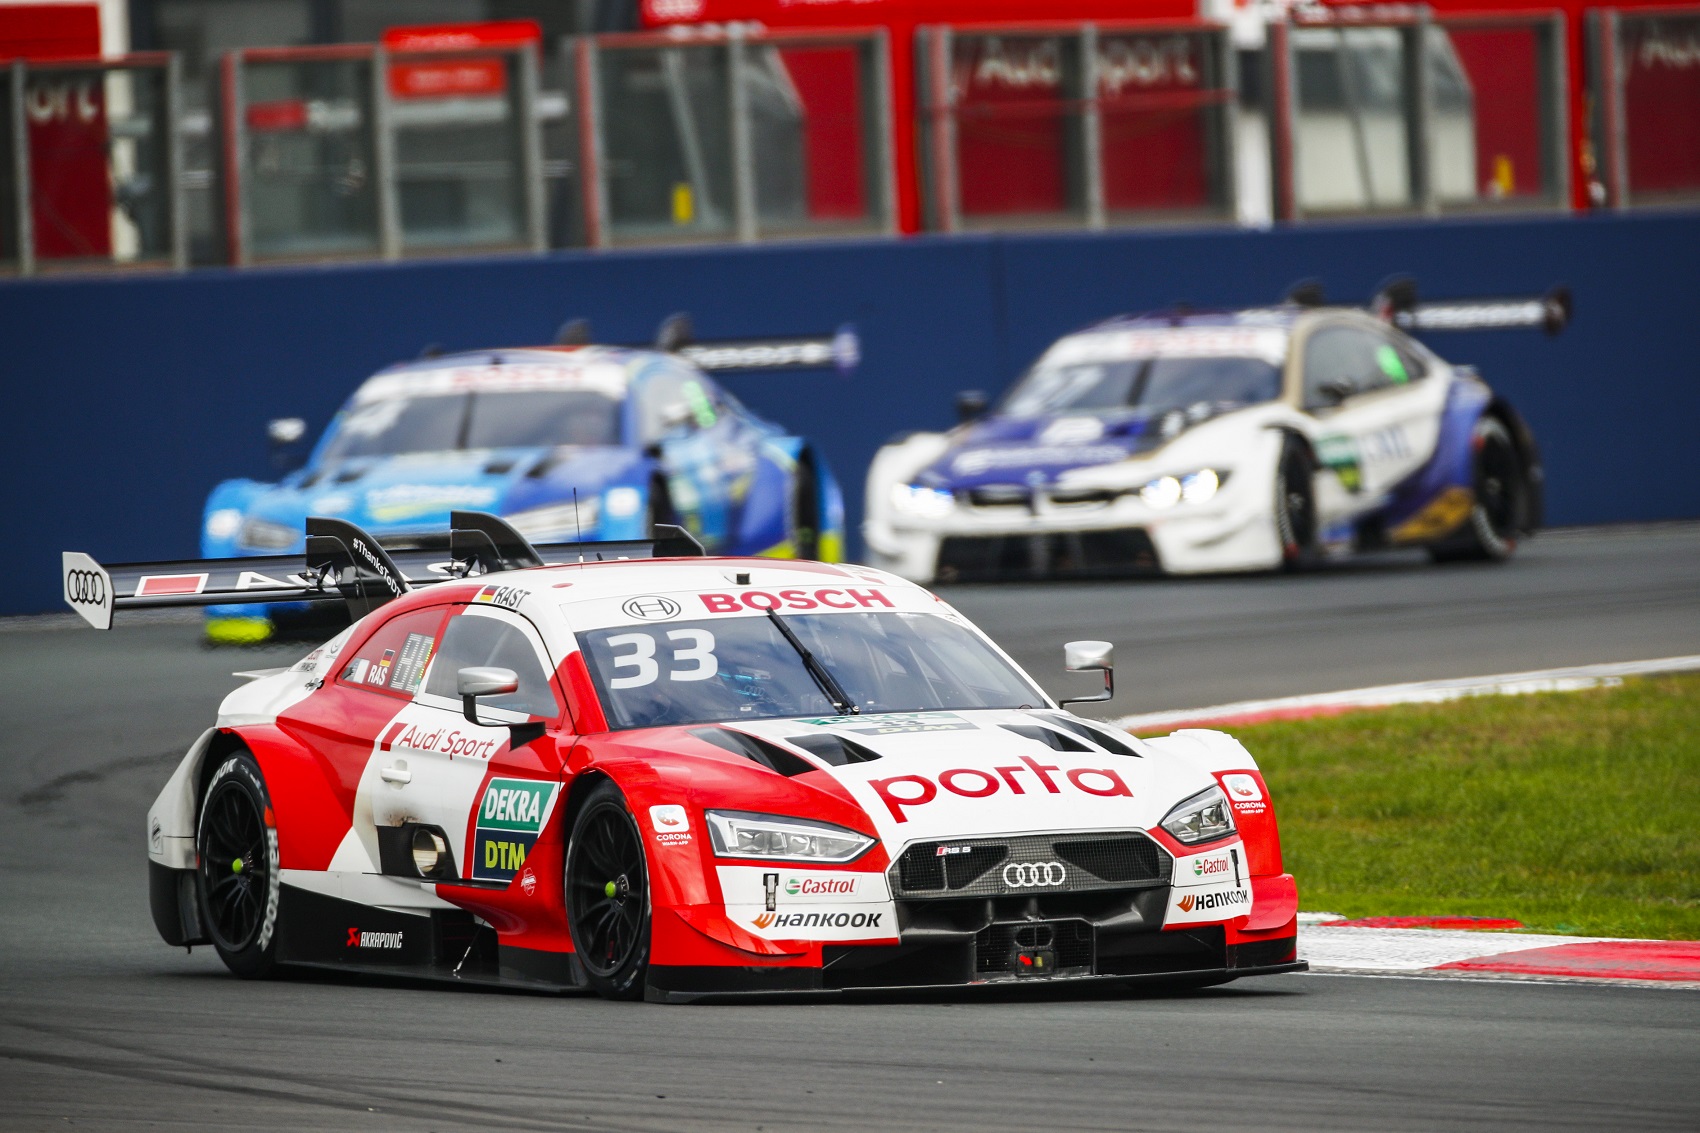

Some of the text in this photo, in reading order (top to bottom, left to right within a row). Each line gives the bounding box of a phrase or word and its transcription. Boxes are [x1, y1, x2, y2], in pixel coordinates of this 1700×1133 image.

[353, 537, 402, 598] #ThanksToDT
[493, 585, 531, 608] RAST
[698, 588, 895, 613] BOSCH
[606, 628, 719, 689] 33
[367, 665, 388, 685] RAS
[398, 725, 495, 760] Audi Sport
[867, 756, 1132, 823] porta
[484, 788, 540, 823] DEKRA
[656, 833, 692, 842] CORONA
[485, 840, 525, 871] DTM
[1203, 857, 1229, 875] Castrol
[802, 878, 855, 895] Castrol
[360, 931, 403, 949] AKRAPOVIČ
